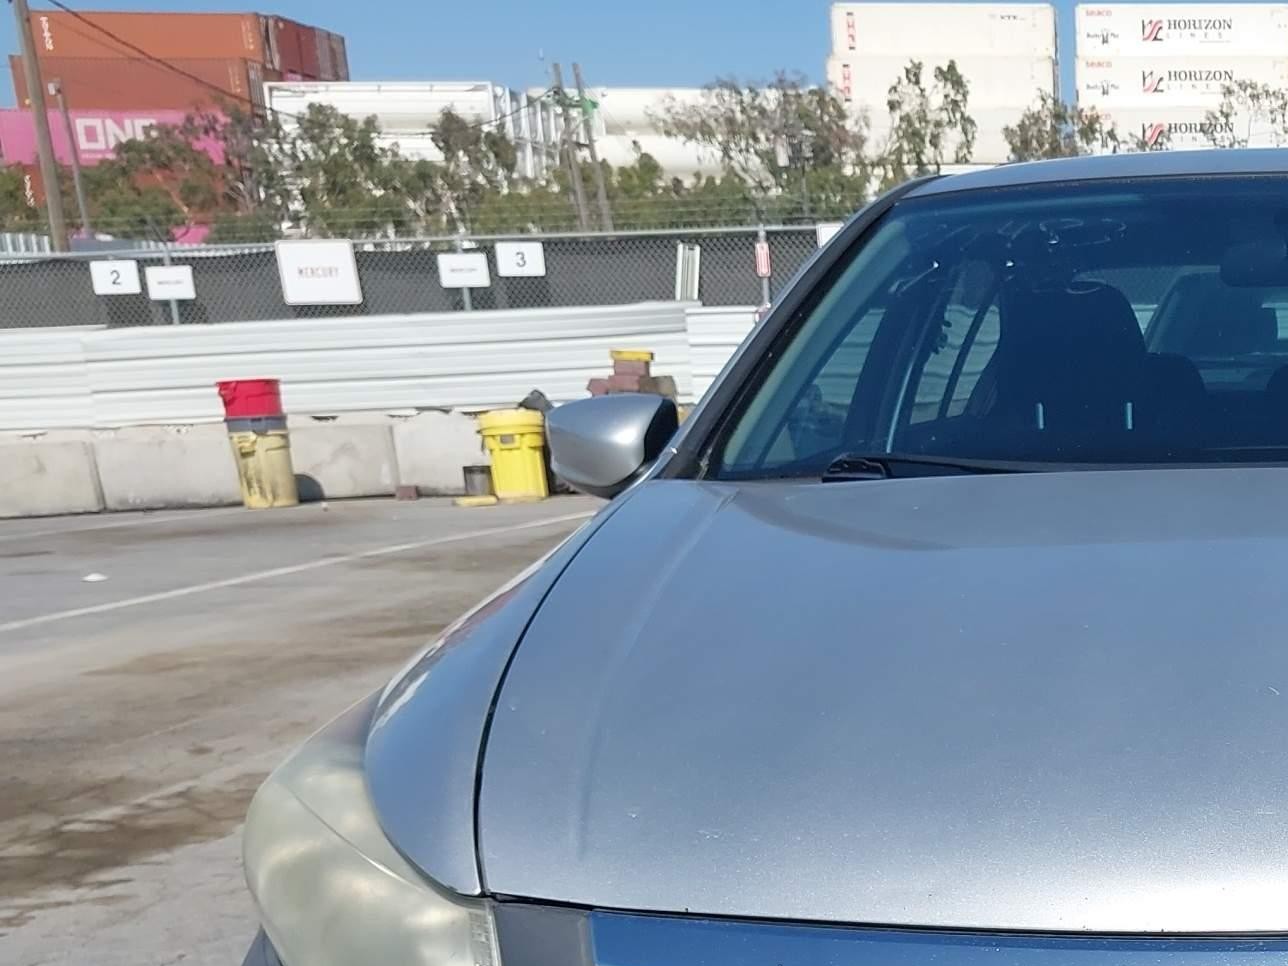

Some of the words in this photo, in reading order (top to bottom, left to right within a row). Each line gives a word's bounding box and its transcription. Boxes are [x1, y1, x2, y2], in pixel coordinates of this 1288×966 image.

[1167, 18, 1232, 30] HORIZON
[1167, 69, 1234, 81] HORIZON
[515, 251, 527, 268] 3
[110, 270, 122, 285] 2
